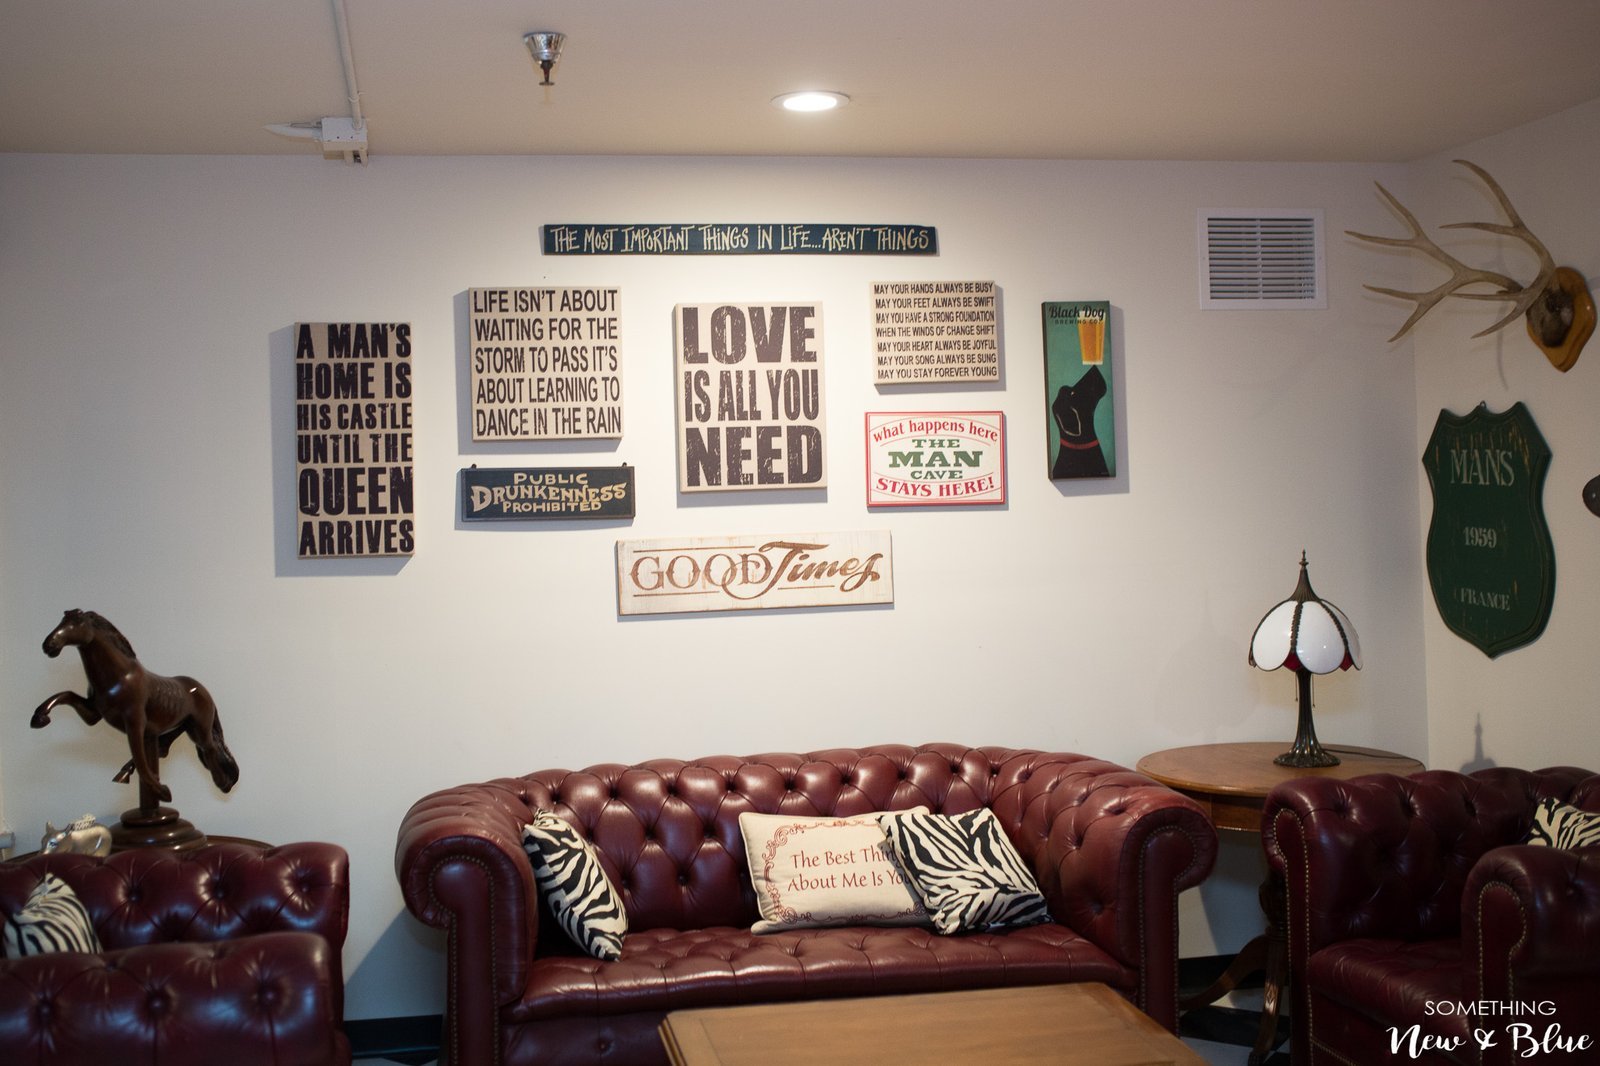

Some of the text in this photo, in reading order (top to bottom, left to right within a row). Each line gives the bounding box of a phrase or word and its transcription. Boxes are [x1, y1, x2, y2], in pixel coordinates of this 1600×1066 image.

[551, 226, 579, 252] THE
[873, 227, 929, 251] THINGS
[874, 282, 993, 294] MAY YOUR HANDS ALWAYS BE BUSY
[474, 290, 617, 313] LIFE ISN'T ABOUT
[875, 296, 994, 309] MAY YOUR FEET ALWAYS BE SWIFT
[1049, 305, 1105, 321] Black Dog
[876, 311, 994, 323] MAY YOU HAVE A STRONG FOUNDATION
[475, 317, 618, 341] WAITING FOR THE
[682, 305, 817, 365] LOVE
[876, 325, 994, 337] WHEN THE WINDS OF CHANGE SHIFT
[297, 323, 411, 359] A MAN'S
[877, 339, 996, 352] MAY YOUR HEART ALWAYS BE JOYFUL
[475, 345, 617, 374] STORM TO PASS IT'S
[877, 353, 996, 366] MAY YOUR SONG ALWAYS BE SUNG
[296, 362, 412, 400] HOME IS
[878, 367, 997, 379] MAY YOU STAY FOREVER YOUNG
[477, 376, 620, 404] ABOUT LEARNING TO
[684, 368, 819, 422] IS ALL YOU
[297, 403, 412, 430] HIS CASTLE
[476, 407, 621, 436] DANCE IN THE RAIN
[873, 420, 998, 443] what happens here
[297, 433, 412, 464] UNTIL THE
[912, 439, 960, 448] THE
[686, 425, 823, 487] NEED
[888, 451, 983, 468] MAN
[513, 472, 588, 485] PUBLIC
[910, 470, 963, 480] CAVE
[1450, 449, 1515, 487] MANS
[299, 466, 413, 516] QUEEN
[471, 482, 627, 513] DRUNKENNESS
[876, 476, 995, 497] STAYS HERE!
[503, 501, 602, 513] PROHIBITED
[299, 519, 414, 555] ARRIVES
[1463, 526, 1497, 548] 1959
[629, 540, 884, 600] GOOD Times
[1460, 587, 1511, 611] FRANCE
[790, 850, 821, 869] The
[824, 850, 856, 866] Best
[788, 873, 838, 892] About
[842, 872, 868, 888] Me
[872, 871, 883, 886] Is
